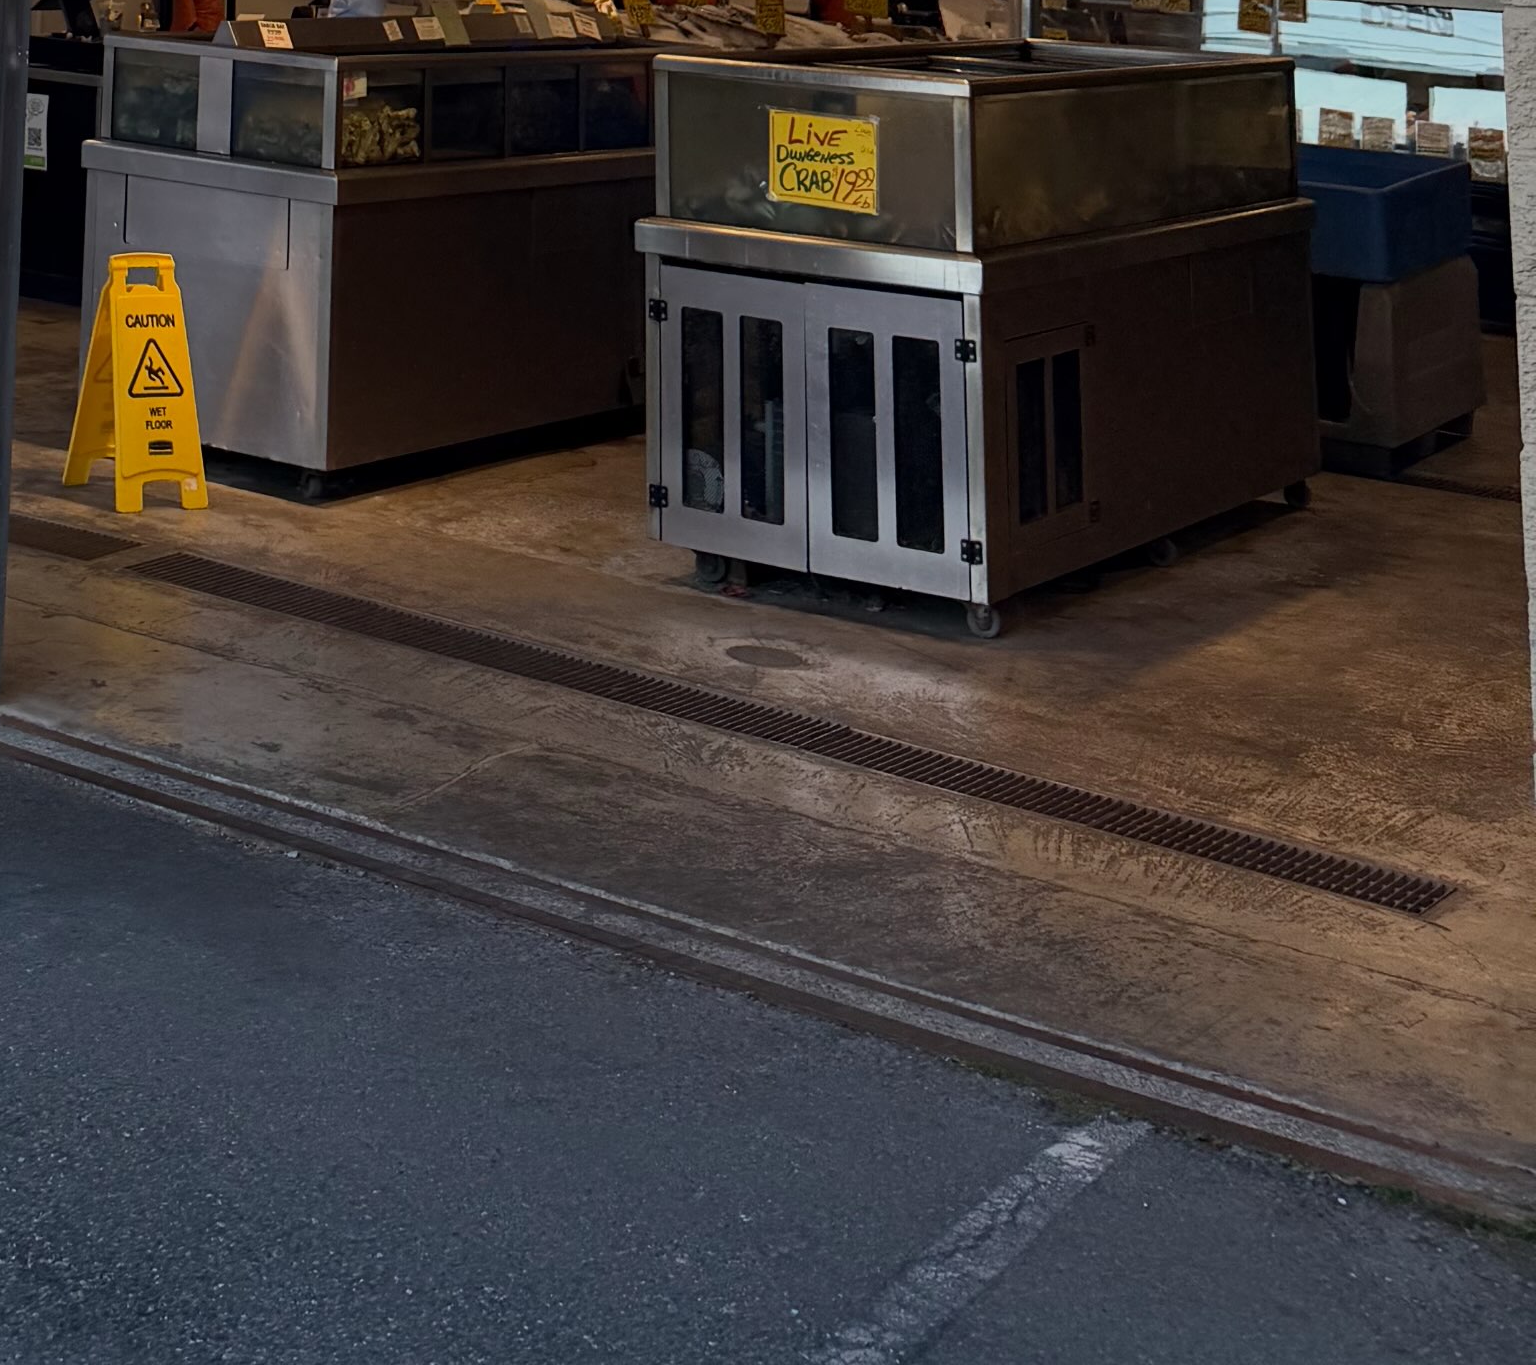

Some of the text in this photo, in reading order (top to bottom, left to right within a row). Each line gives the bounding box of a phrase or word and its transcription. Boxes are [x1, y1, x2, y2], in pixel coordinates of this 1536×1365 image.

[779, 162, 835, 194] CRAB
[124, 313, 176, 329] CAUTION
[148, 406, 167, 417] WET
[145, 420, 174, 431] FLOOR
